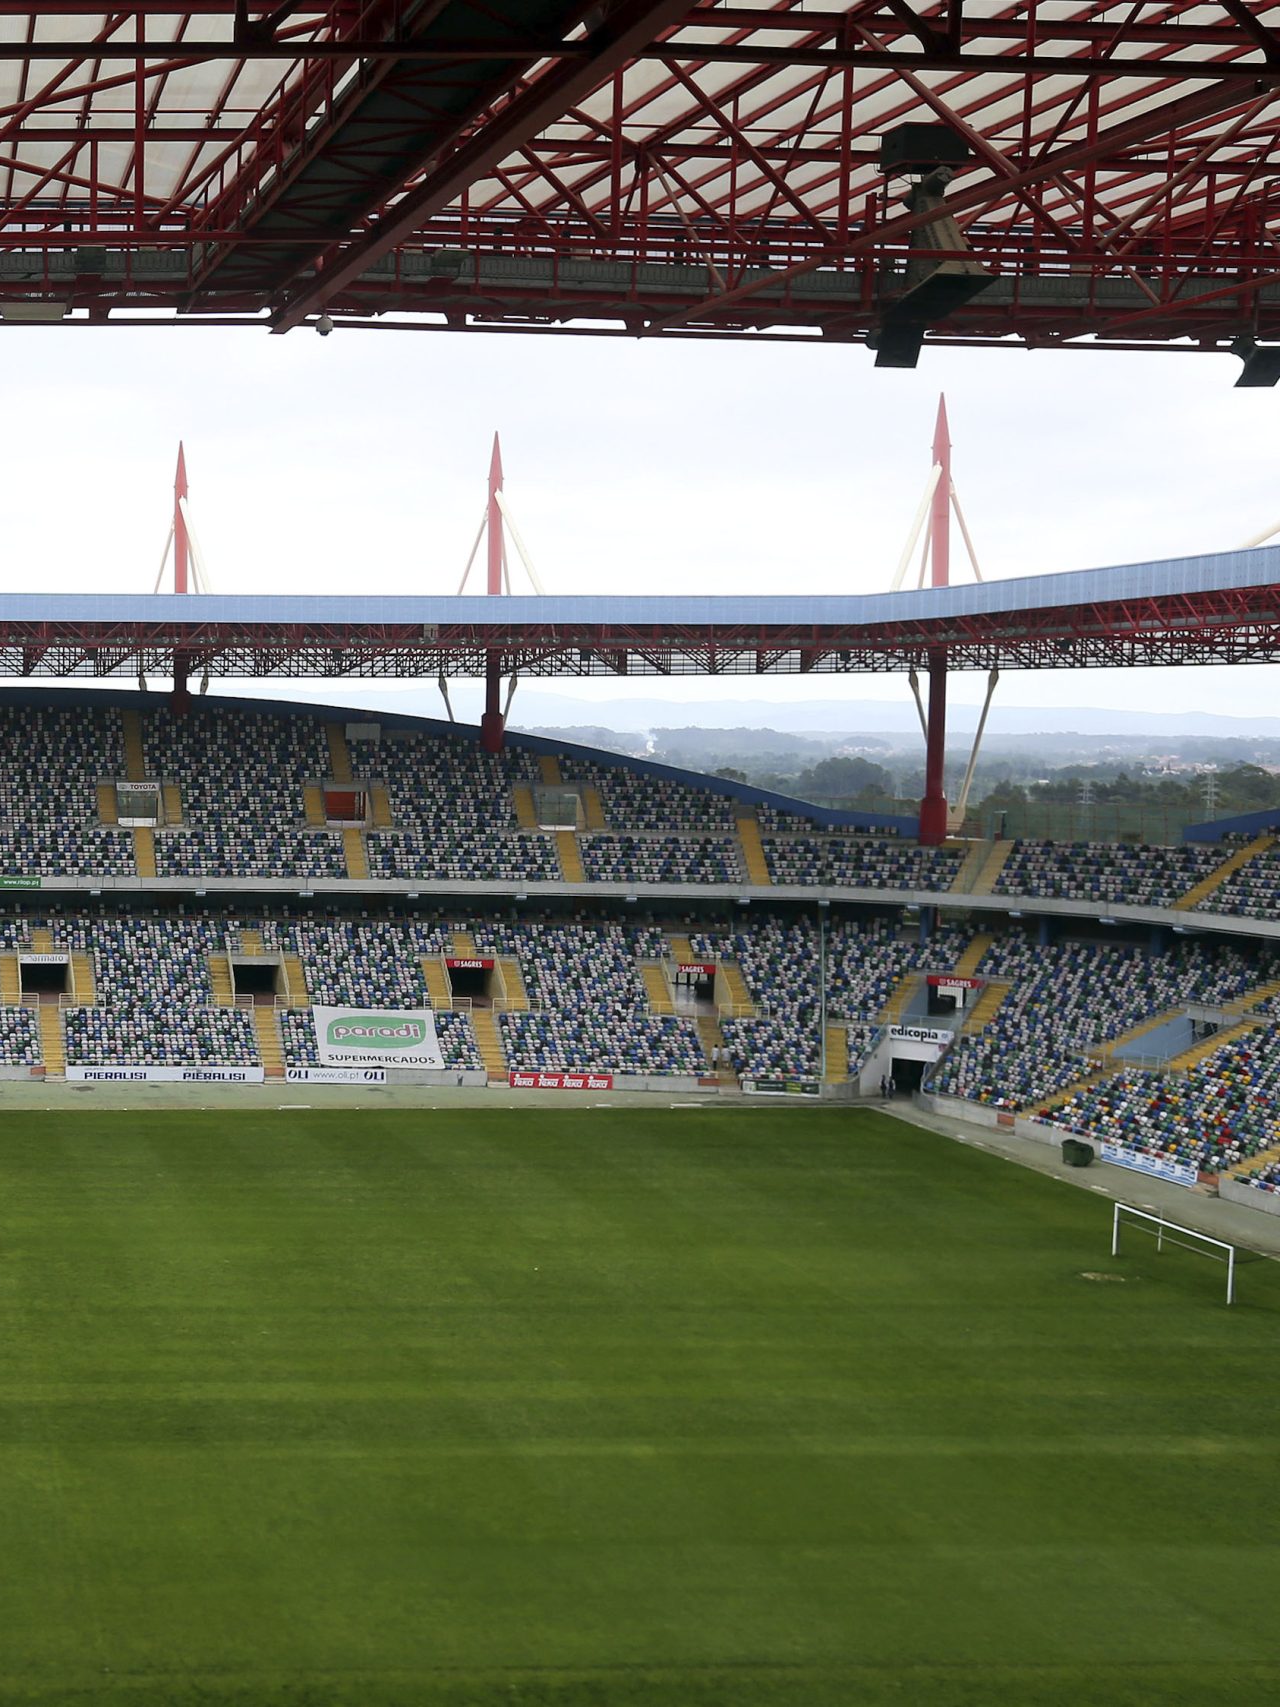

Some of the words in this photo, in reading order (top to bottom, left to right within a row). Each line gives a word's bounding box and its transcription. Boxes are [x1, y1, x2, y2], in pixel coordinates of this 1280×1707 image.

[460, 960, 483, 968] SAGRES
[681, 965, 705, 973] SAGRES
[946, 979, 972, 988] SAGRES
[333, 1023, 421, 1040] paradi
[891, 1025, 938, 1042] edicopia
[327, 1054, 436, 1064] SUPERMERCADOS
[288, 1069, 308, 1079] OLI
[313, 1071, 359, 1079] www.oli.pt
[364, 1070, 385, 1080] OLI
